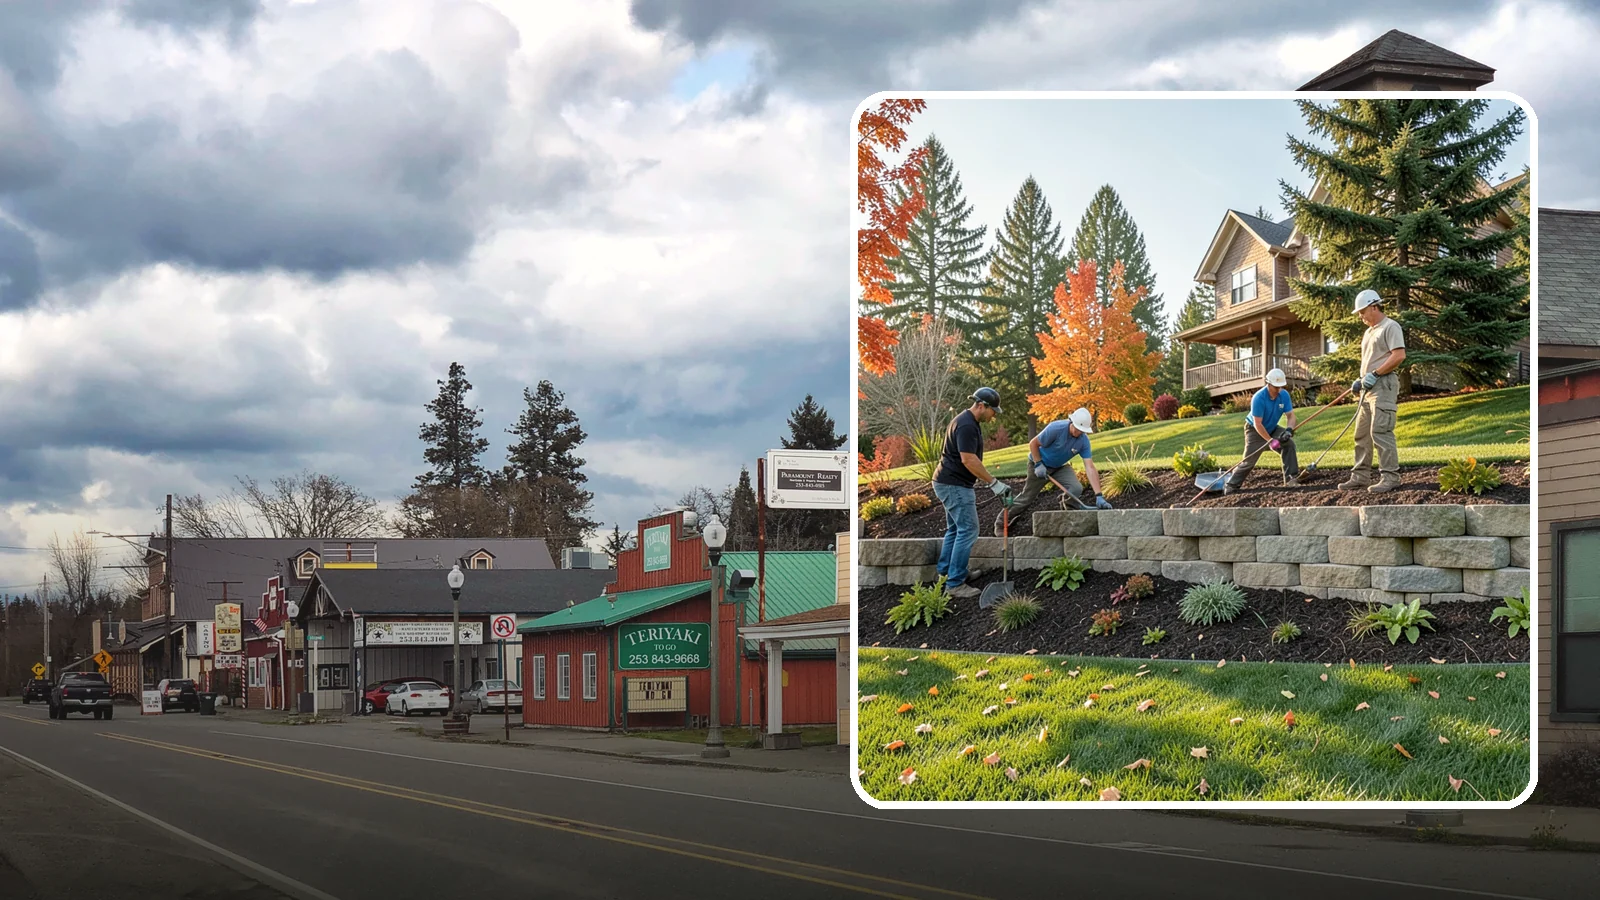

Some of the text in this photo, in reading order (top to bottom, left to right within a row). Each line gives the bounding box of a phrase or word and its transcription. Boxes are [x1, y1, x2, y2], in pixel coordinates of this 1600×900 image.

[781, 471, 839, 480] PARAMOUNT REALTY
[624, 627, 702, 646] TERIYAKI
[629, 654, 700, 664] 253 843-9668
[639, 681, 672, 690] TERIYAKI
